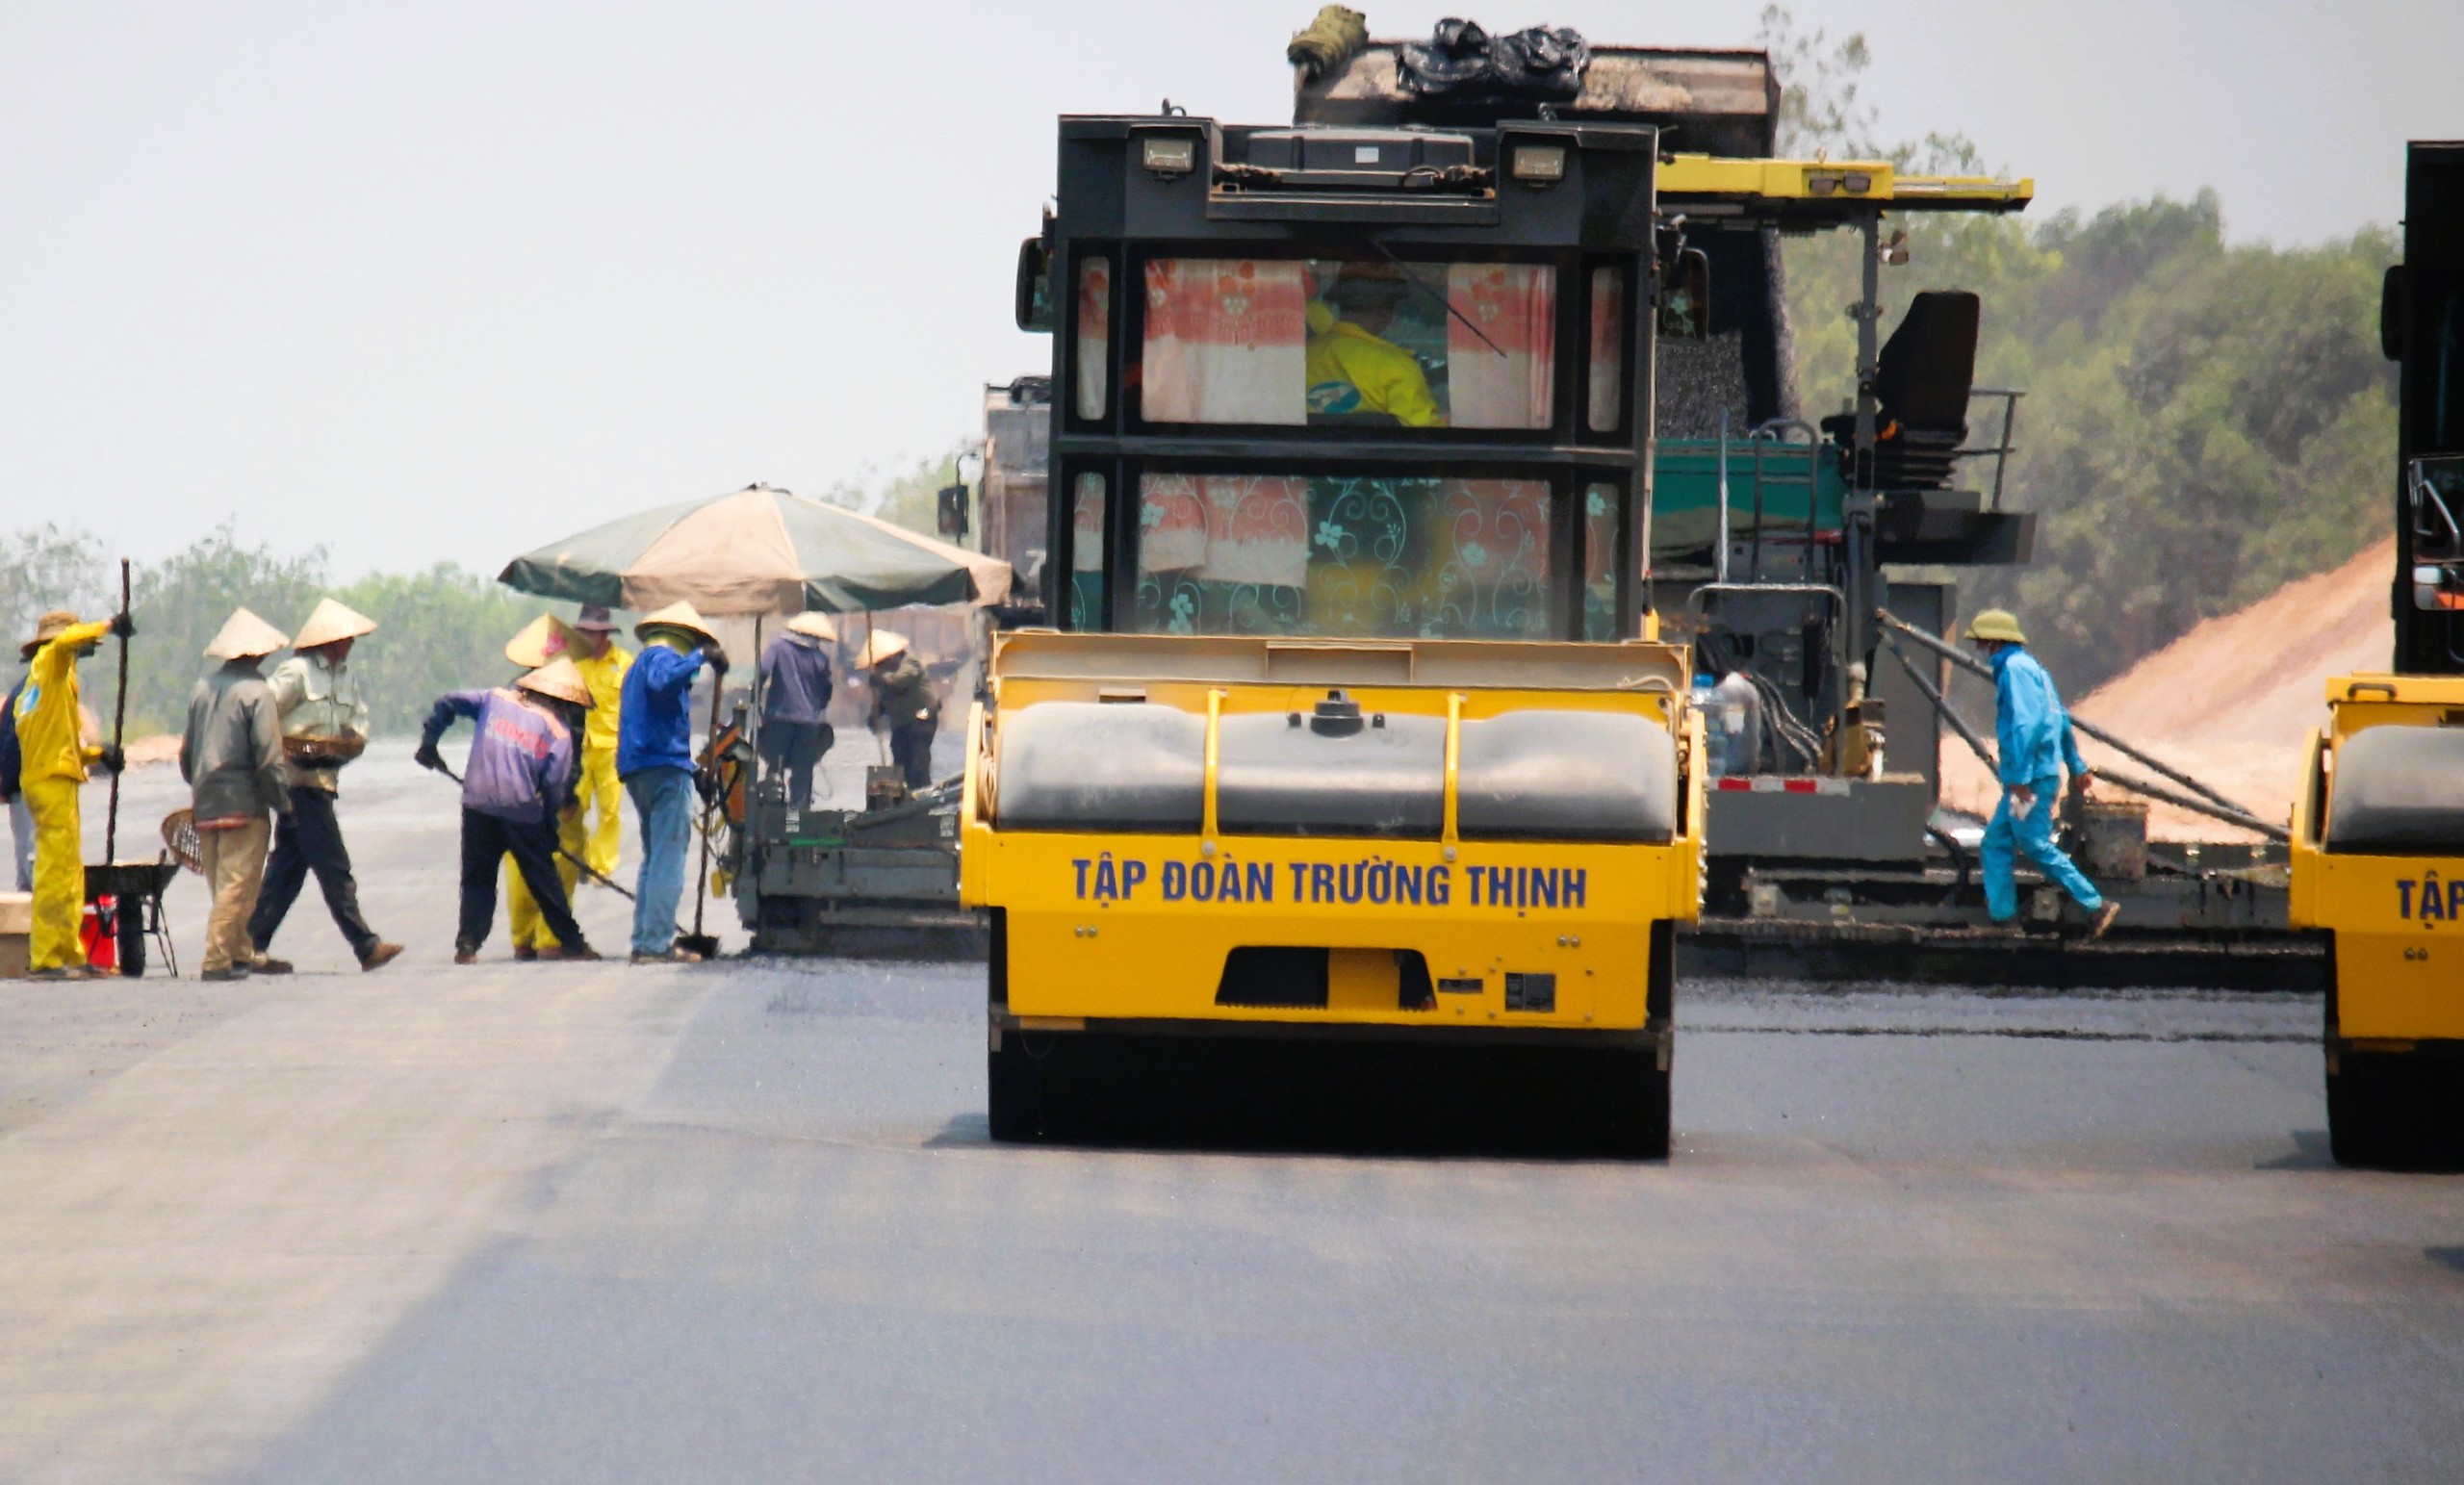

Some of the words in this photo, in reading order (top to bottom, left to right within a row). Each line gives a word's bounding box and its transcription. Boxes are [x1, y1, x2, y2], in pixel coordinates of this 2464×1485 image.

[1071, 851, 1147, 909] TẬP
[1161, 852, 1274, 903] ĐOÀN
[1289, 855, 1450, 907] TRƯỜNG
[1465, 866, 1587, 918] THỊNH
